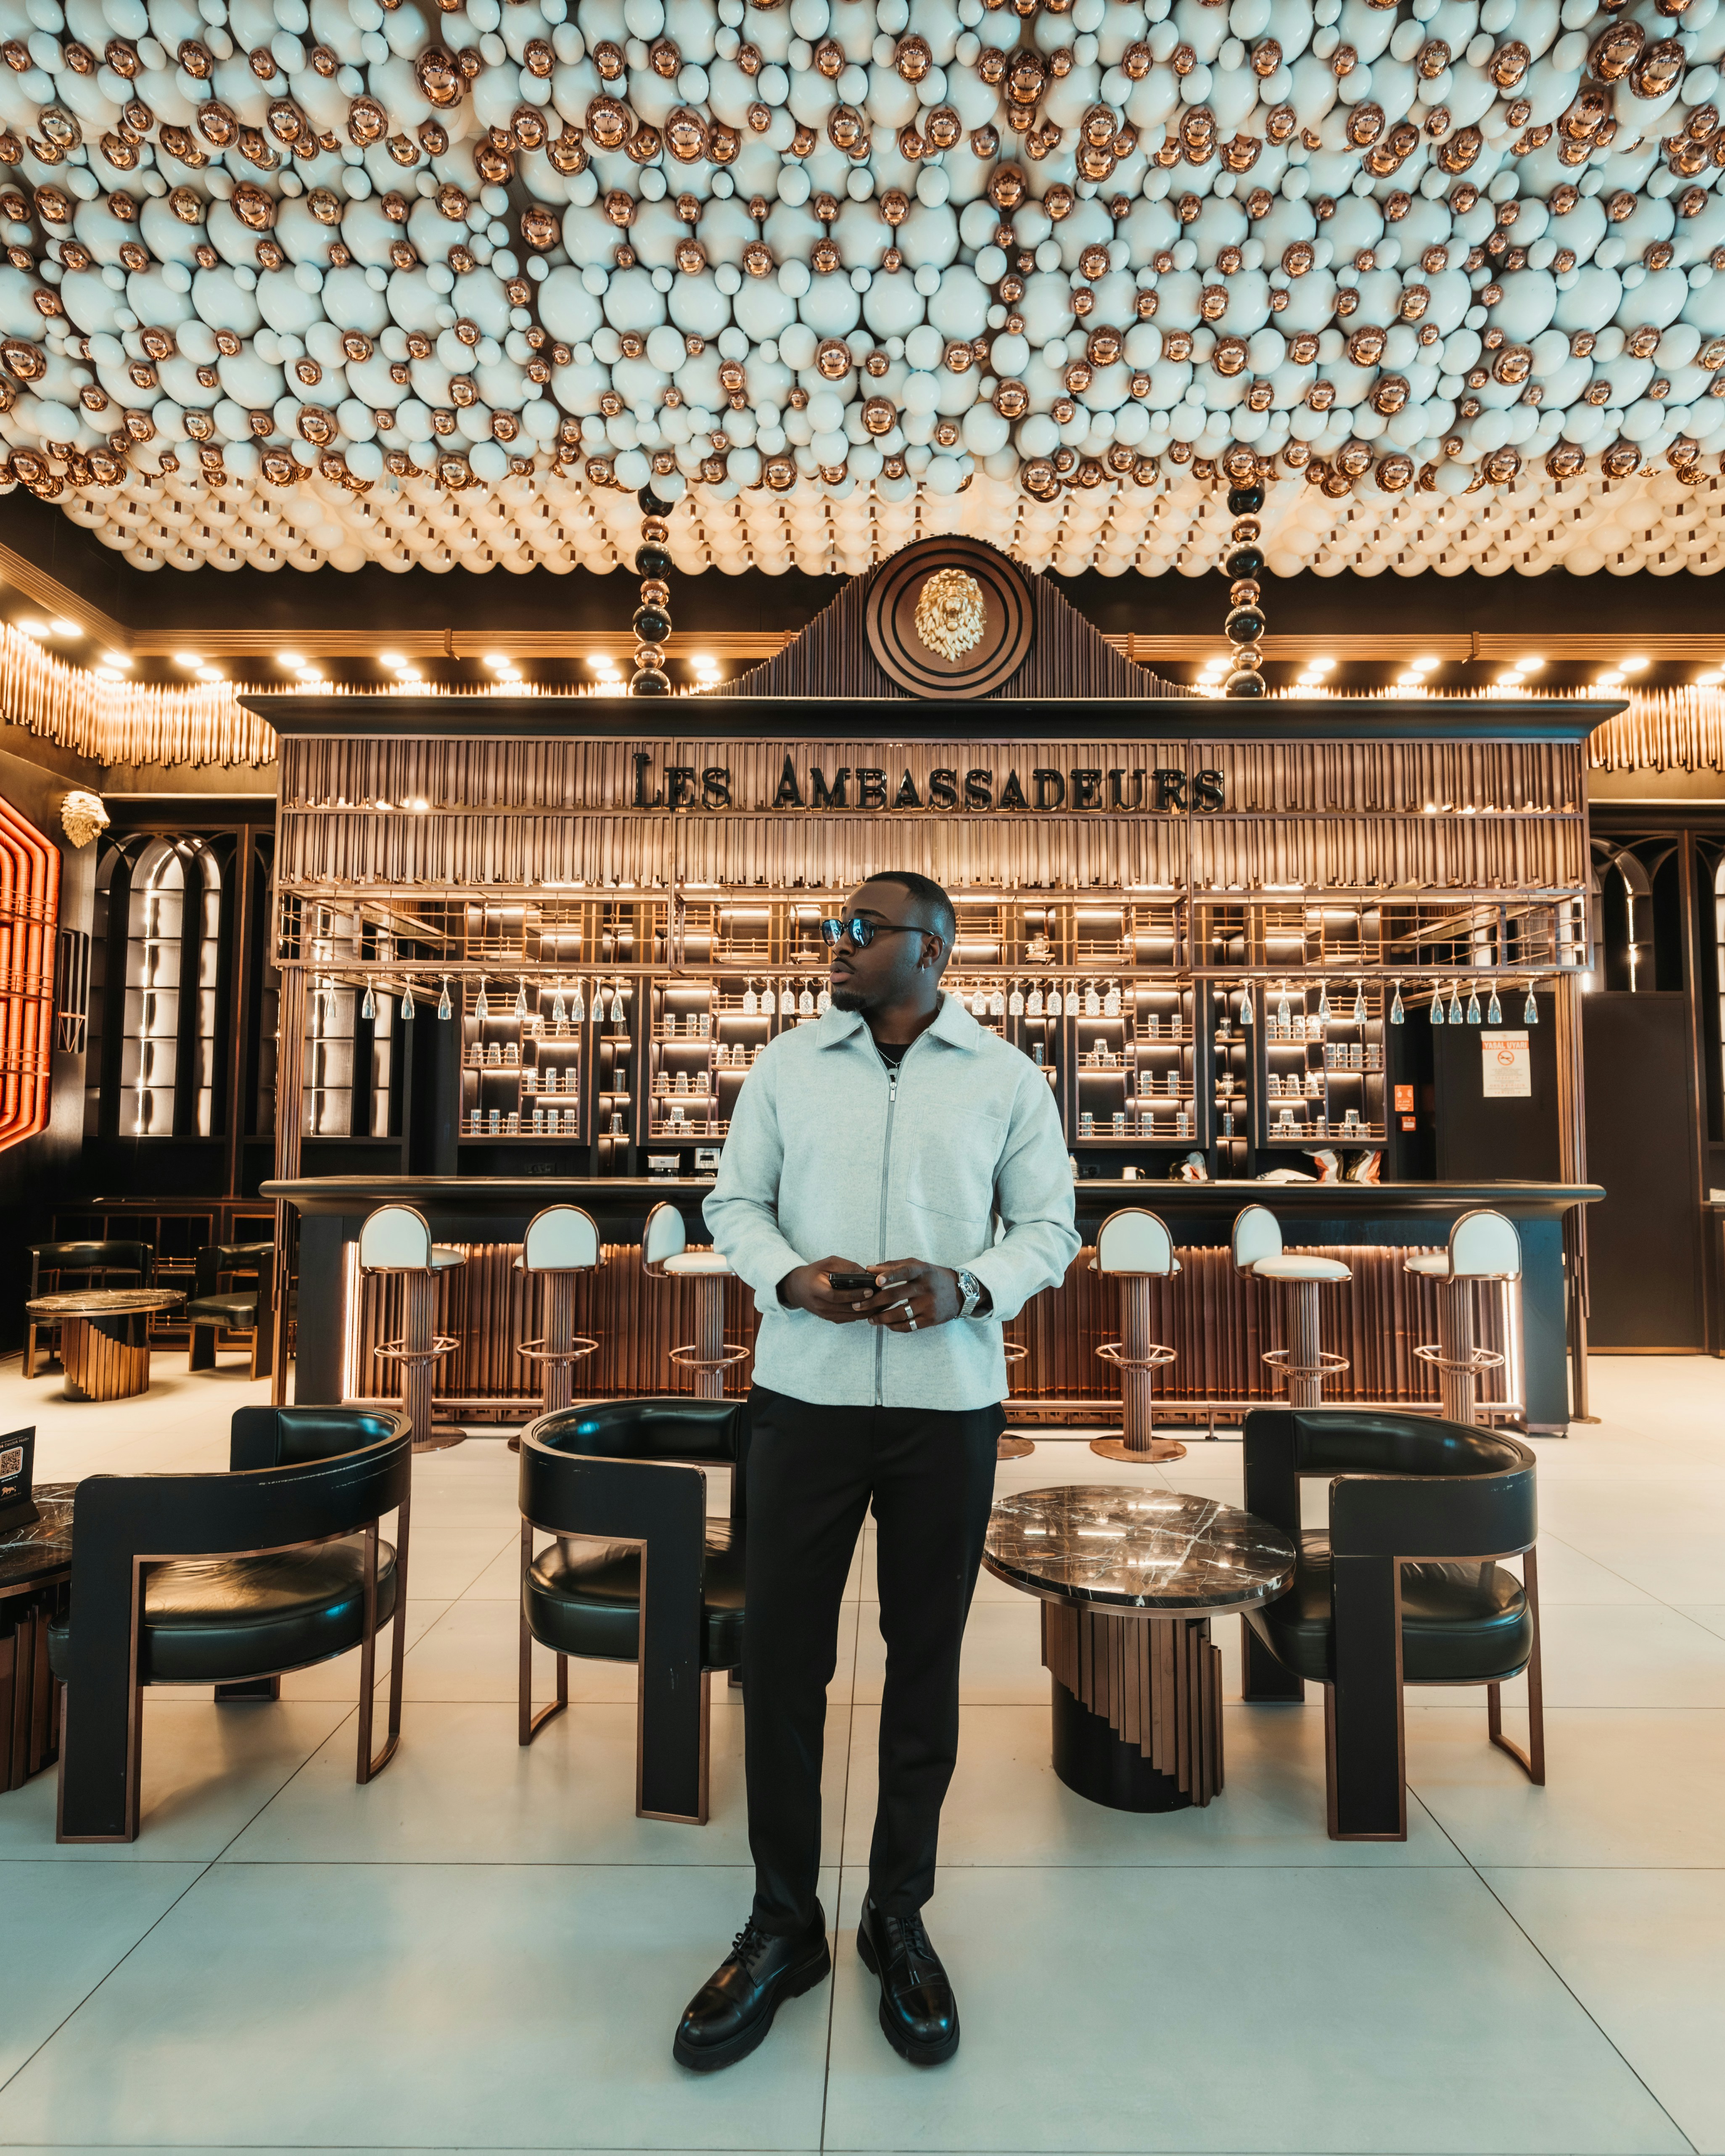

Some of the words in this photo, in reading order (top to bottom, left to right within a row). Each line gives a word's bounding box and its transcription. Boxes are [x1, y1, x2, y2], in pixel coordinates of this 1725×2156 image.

[632, 752, 731, 809] LES
[772, 754, 1225, 810] AMBASSADEURS
[1506, 1041, 1527, 1049] UYARI
